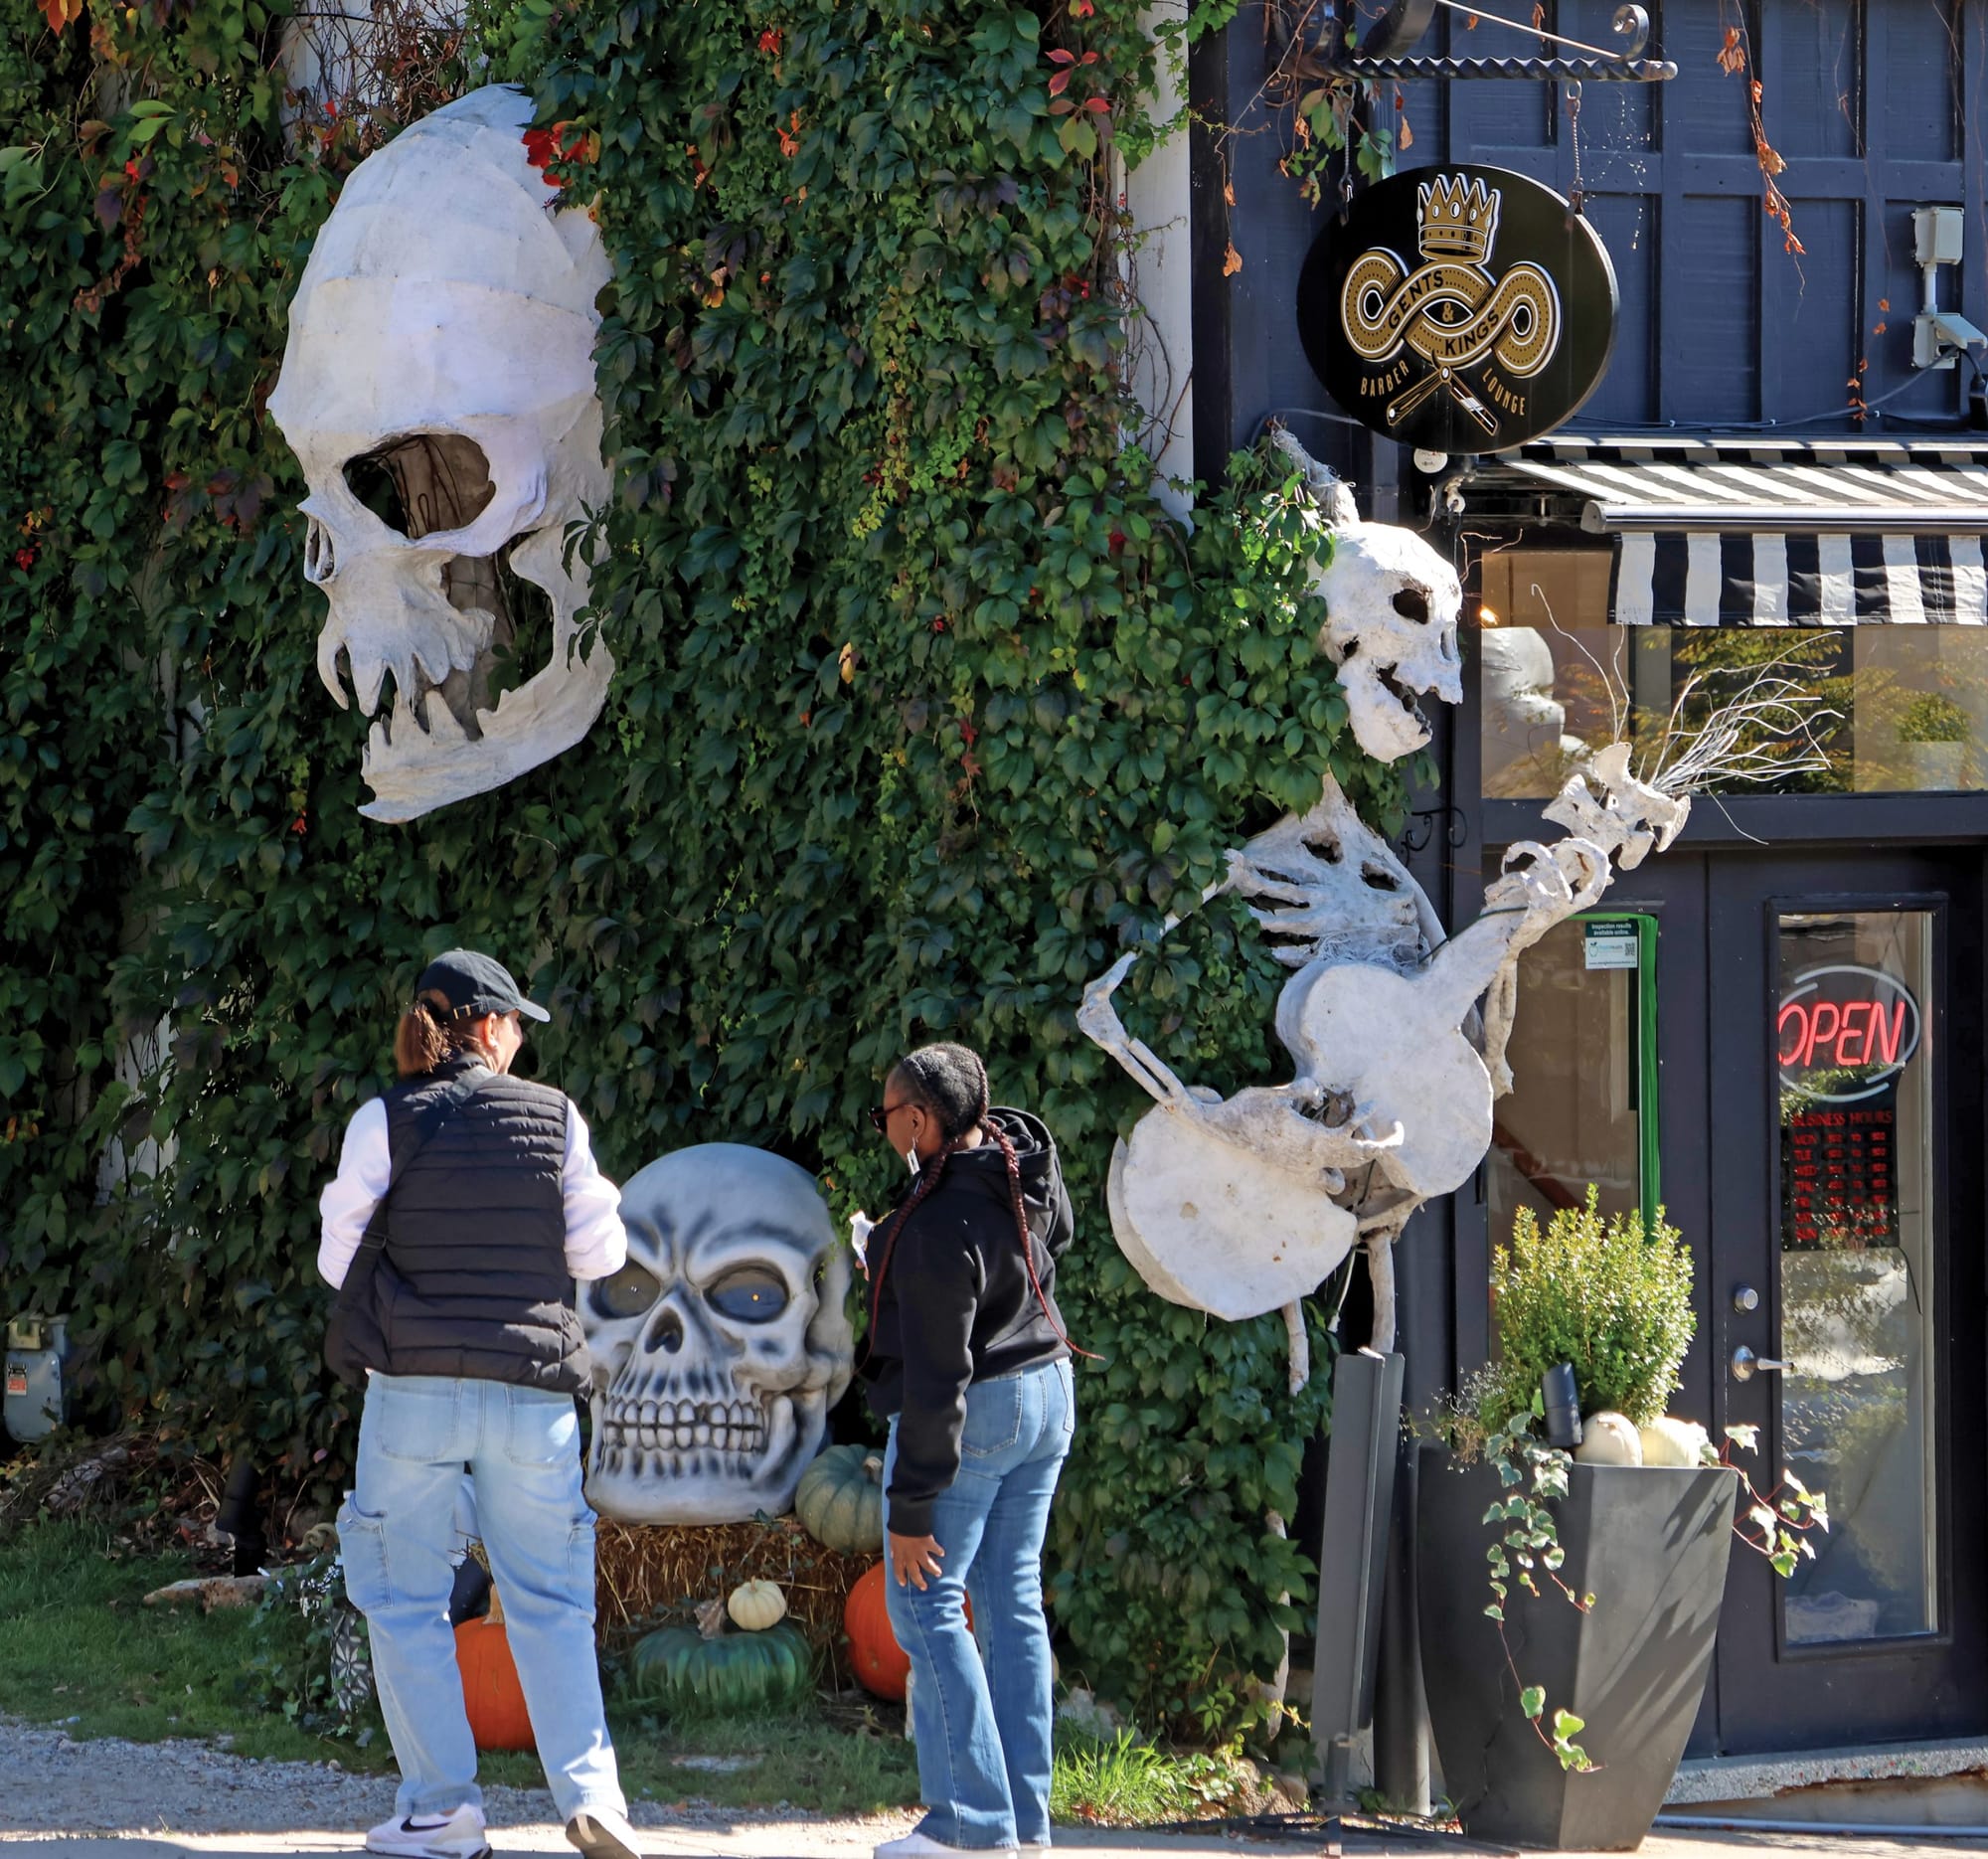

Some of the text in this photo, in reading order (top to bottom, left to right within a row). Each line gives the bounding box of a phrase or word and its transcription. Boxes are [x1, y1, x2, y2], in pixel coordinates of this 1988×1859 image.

[1388, 269, 1443, 329] GENTS
[1442, 301, 1454, 322] &
[1444, 309, 1499, 356] KINGS
[1360, 359, 1526, 416] BARBER LOUNGE
[1778, 1001, 1905, 1067] OPEN
